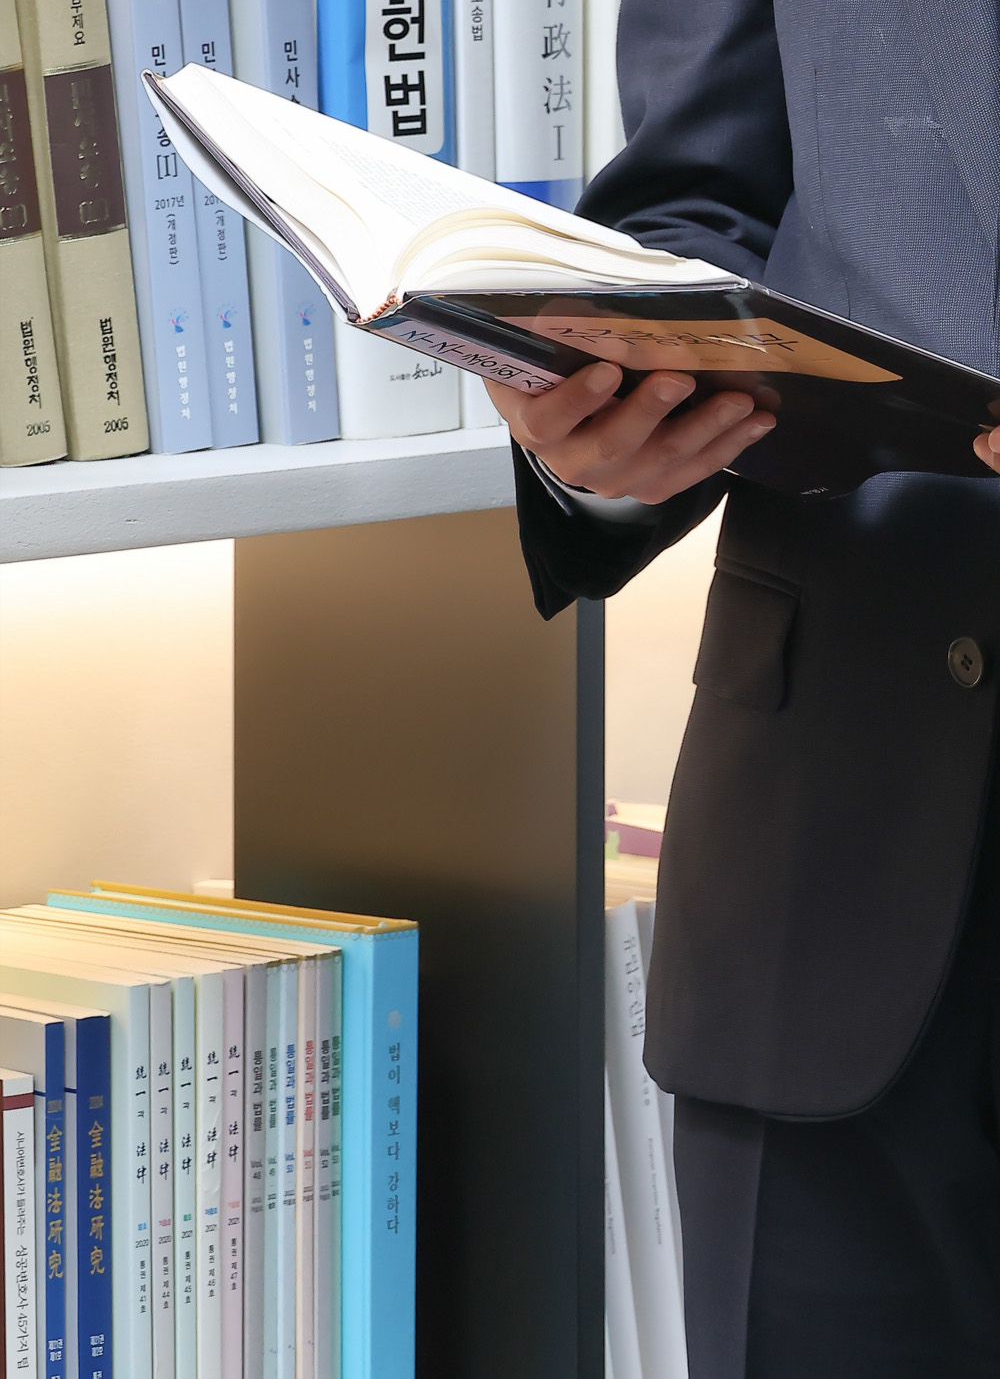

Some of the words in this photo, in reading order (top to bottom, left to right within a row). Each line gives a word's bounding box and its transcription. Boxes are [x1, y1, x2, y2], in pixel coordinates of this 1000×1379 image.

[283, 39, 303, 105] 민사
[155, 195, 185, 212] 2017년
[204, 195, 221, 211] 201
[168, 213, 181, 267] (개정판)
[20, 317, 42, 409] 법원행정처
[99, 316, 120, 406] 법원행정처
[175, 344, 192, 421] 법원행정처
[223, 339, 239, 416] 법원행정처
[302, 336, 319, 413] 법원행정처
[27, 420, 52, 437] 2005
[104, 417, 130, 434] 2005
[388, 1041, 401, 1085] 법이
[386, 1171, 401, 1235] 강하다
[16, 1244, 28, 1310] 성공변호사
[17, 1312, 29, 1353] 45가지
